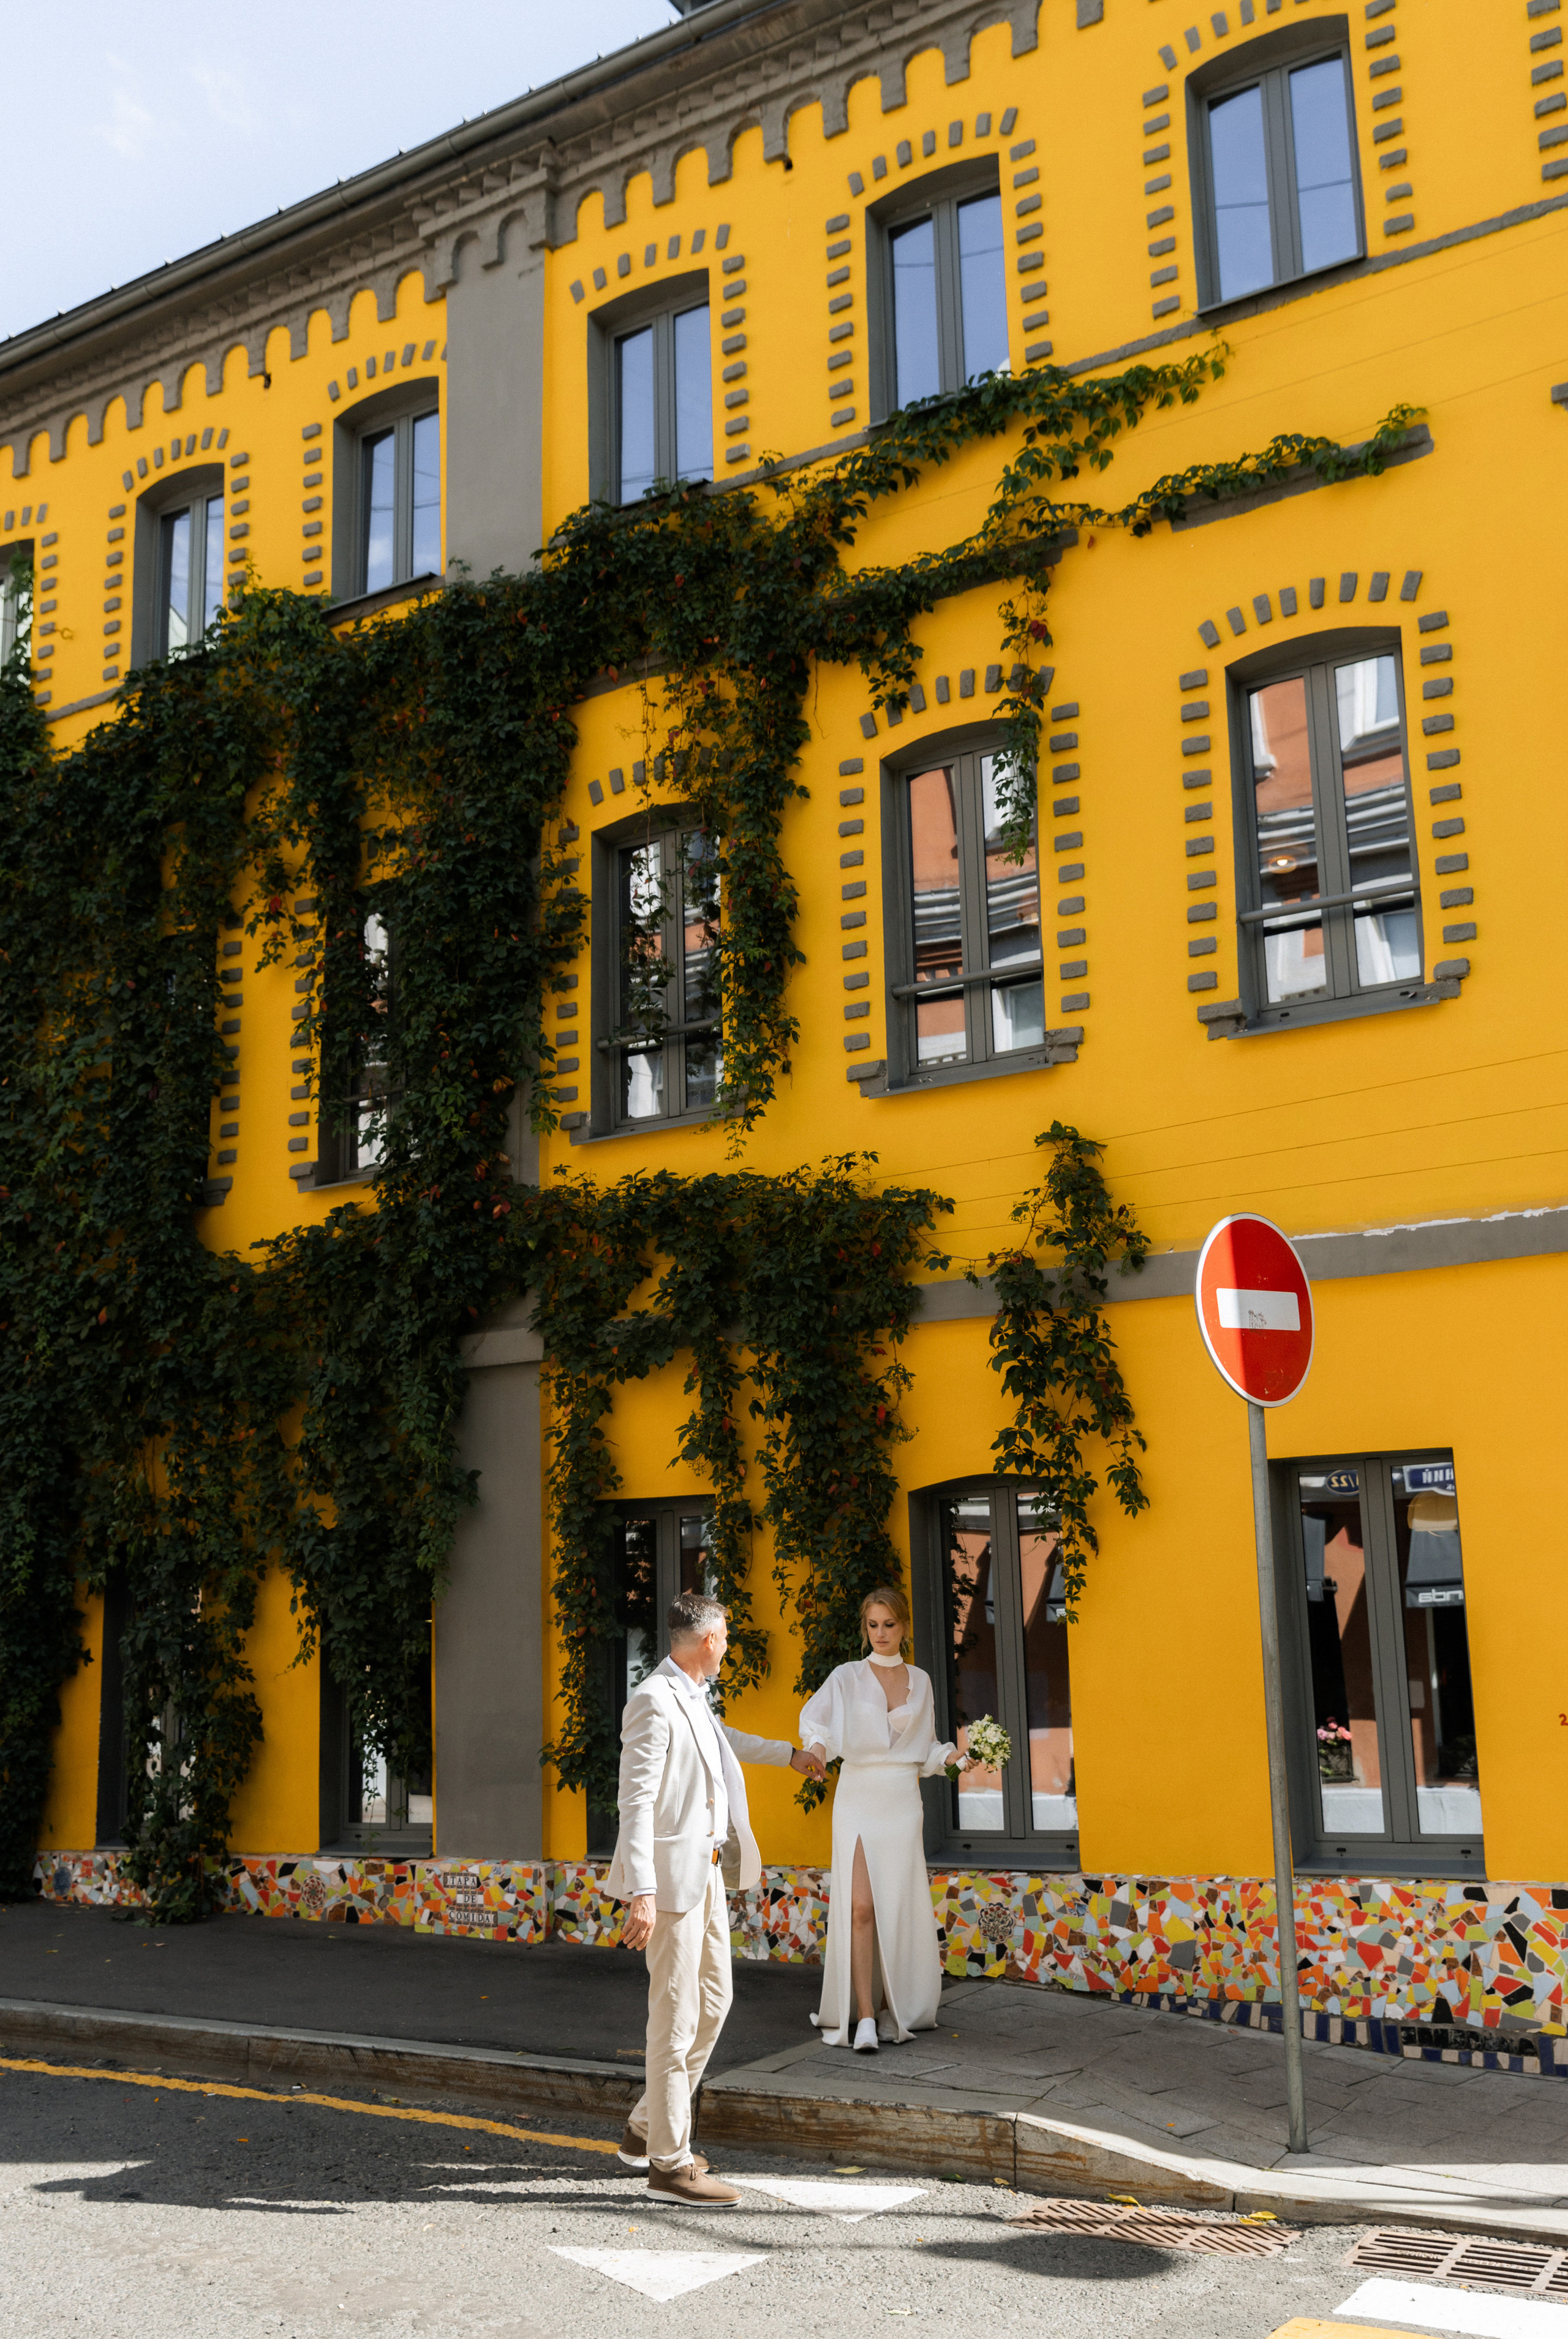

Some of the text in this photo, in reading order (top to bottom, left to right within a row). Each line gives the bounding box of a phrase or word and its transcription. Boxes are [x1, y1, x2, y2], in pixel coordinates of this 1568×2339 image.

[450, 1876, 476, 1886] TAPA
[464, 1894, 477, 1903] DE
[449, 1911, 491, 1923] COMIDA
